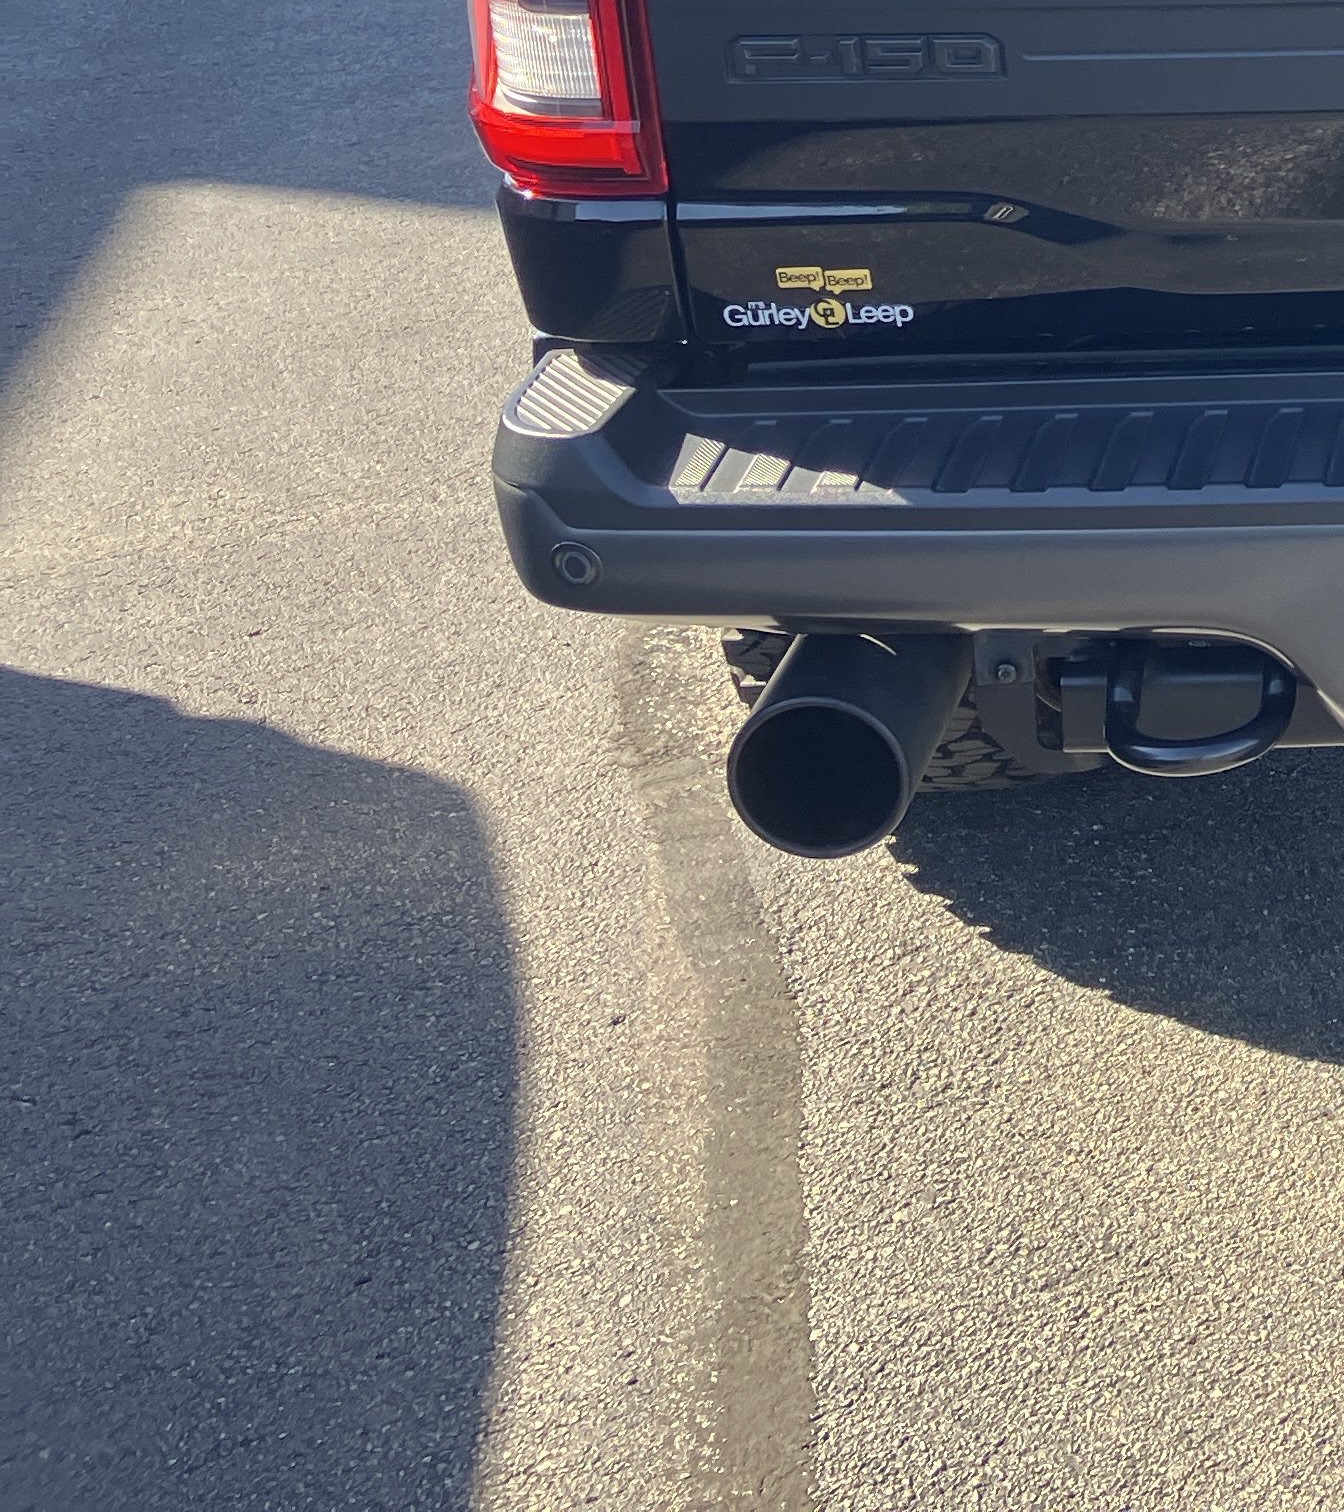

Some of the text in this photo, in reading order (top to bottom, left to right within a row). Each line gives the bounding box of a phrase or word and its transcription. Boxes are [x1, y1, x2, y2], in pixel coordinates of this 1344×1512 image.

[727, 34, 1007, 82] F-150
[778, 271, 868, 287] Beep! Beep!
[846, 303, 914, 327] Leep
